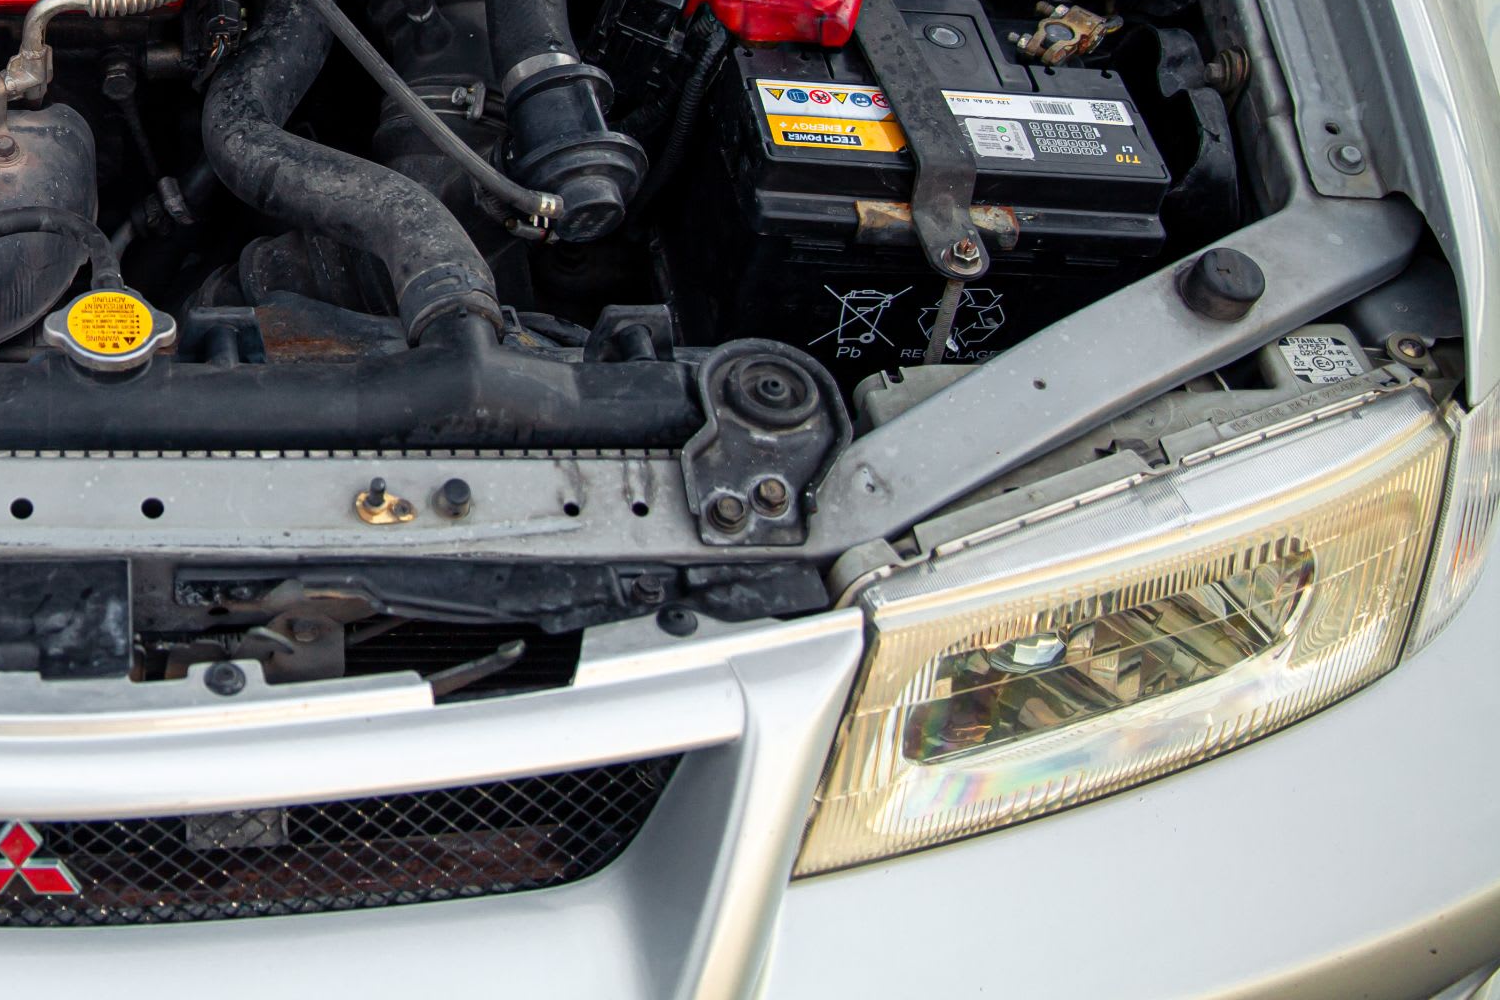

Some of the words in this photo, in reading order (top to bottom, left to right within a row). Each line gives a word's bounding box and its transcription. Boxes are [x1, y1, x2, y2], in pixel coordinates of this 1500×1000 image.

[792, 122, 843, 132] ENERGY
[787, 132, 822, 142] POWER
[824, 136, 857, 144] TECH
[1115, 154, 1141, 164] T10
[836, 346, 861, 359] Pb
[1317, 359, 1331, 368] E4
[1345, 367, 1358, 377] L
